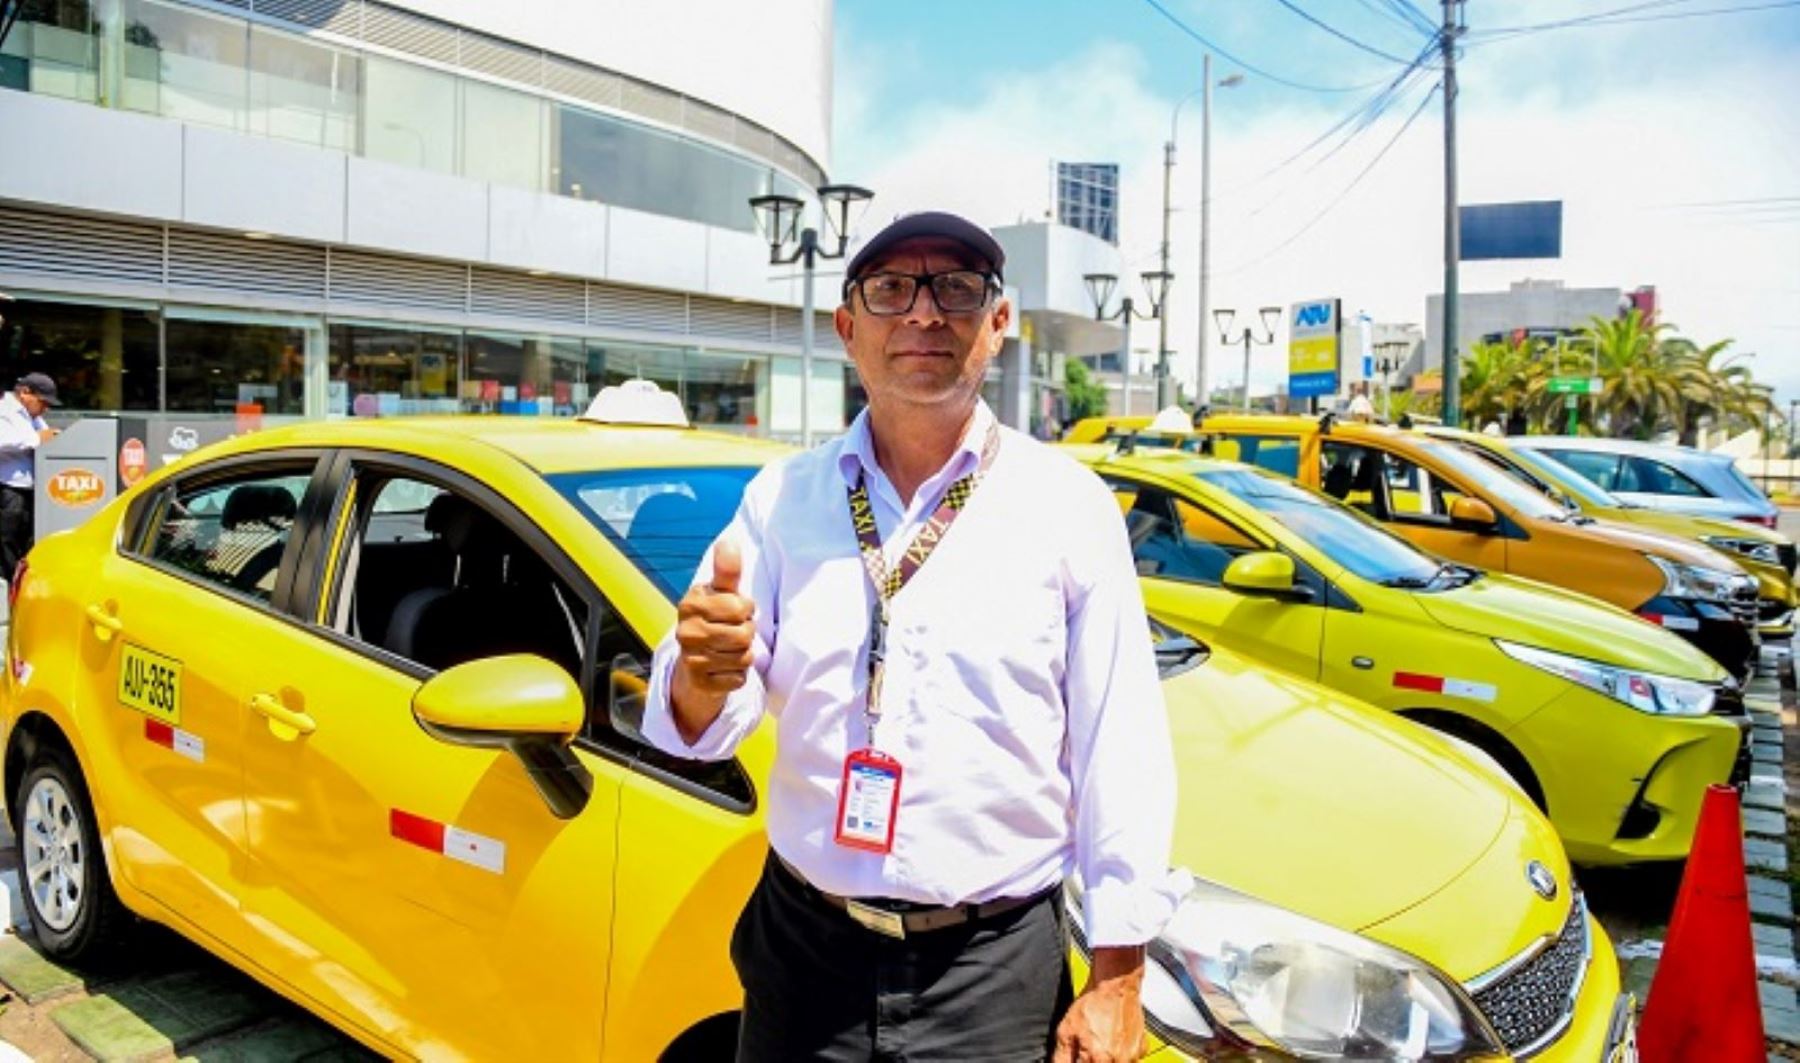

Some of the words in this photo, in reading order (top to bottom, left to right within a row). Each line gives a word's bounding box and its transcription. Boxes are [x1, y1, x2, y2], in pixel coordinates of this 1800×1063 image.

[1294, 303, 1331, 326] ATU
[55, 475, 99, 491] TAXI
[849, 486, 876, 534] TAXI
[906, 517, 949, 566] TAXI
